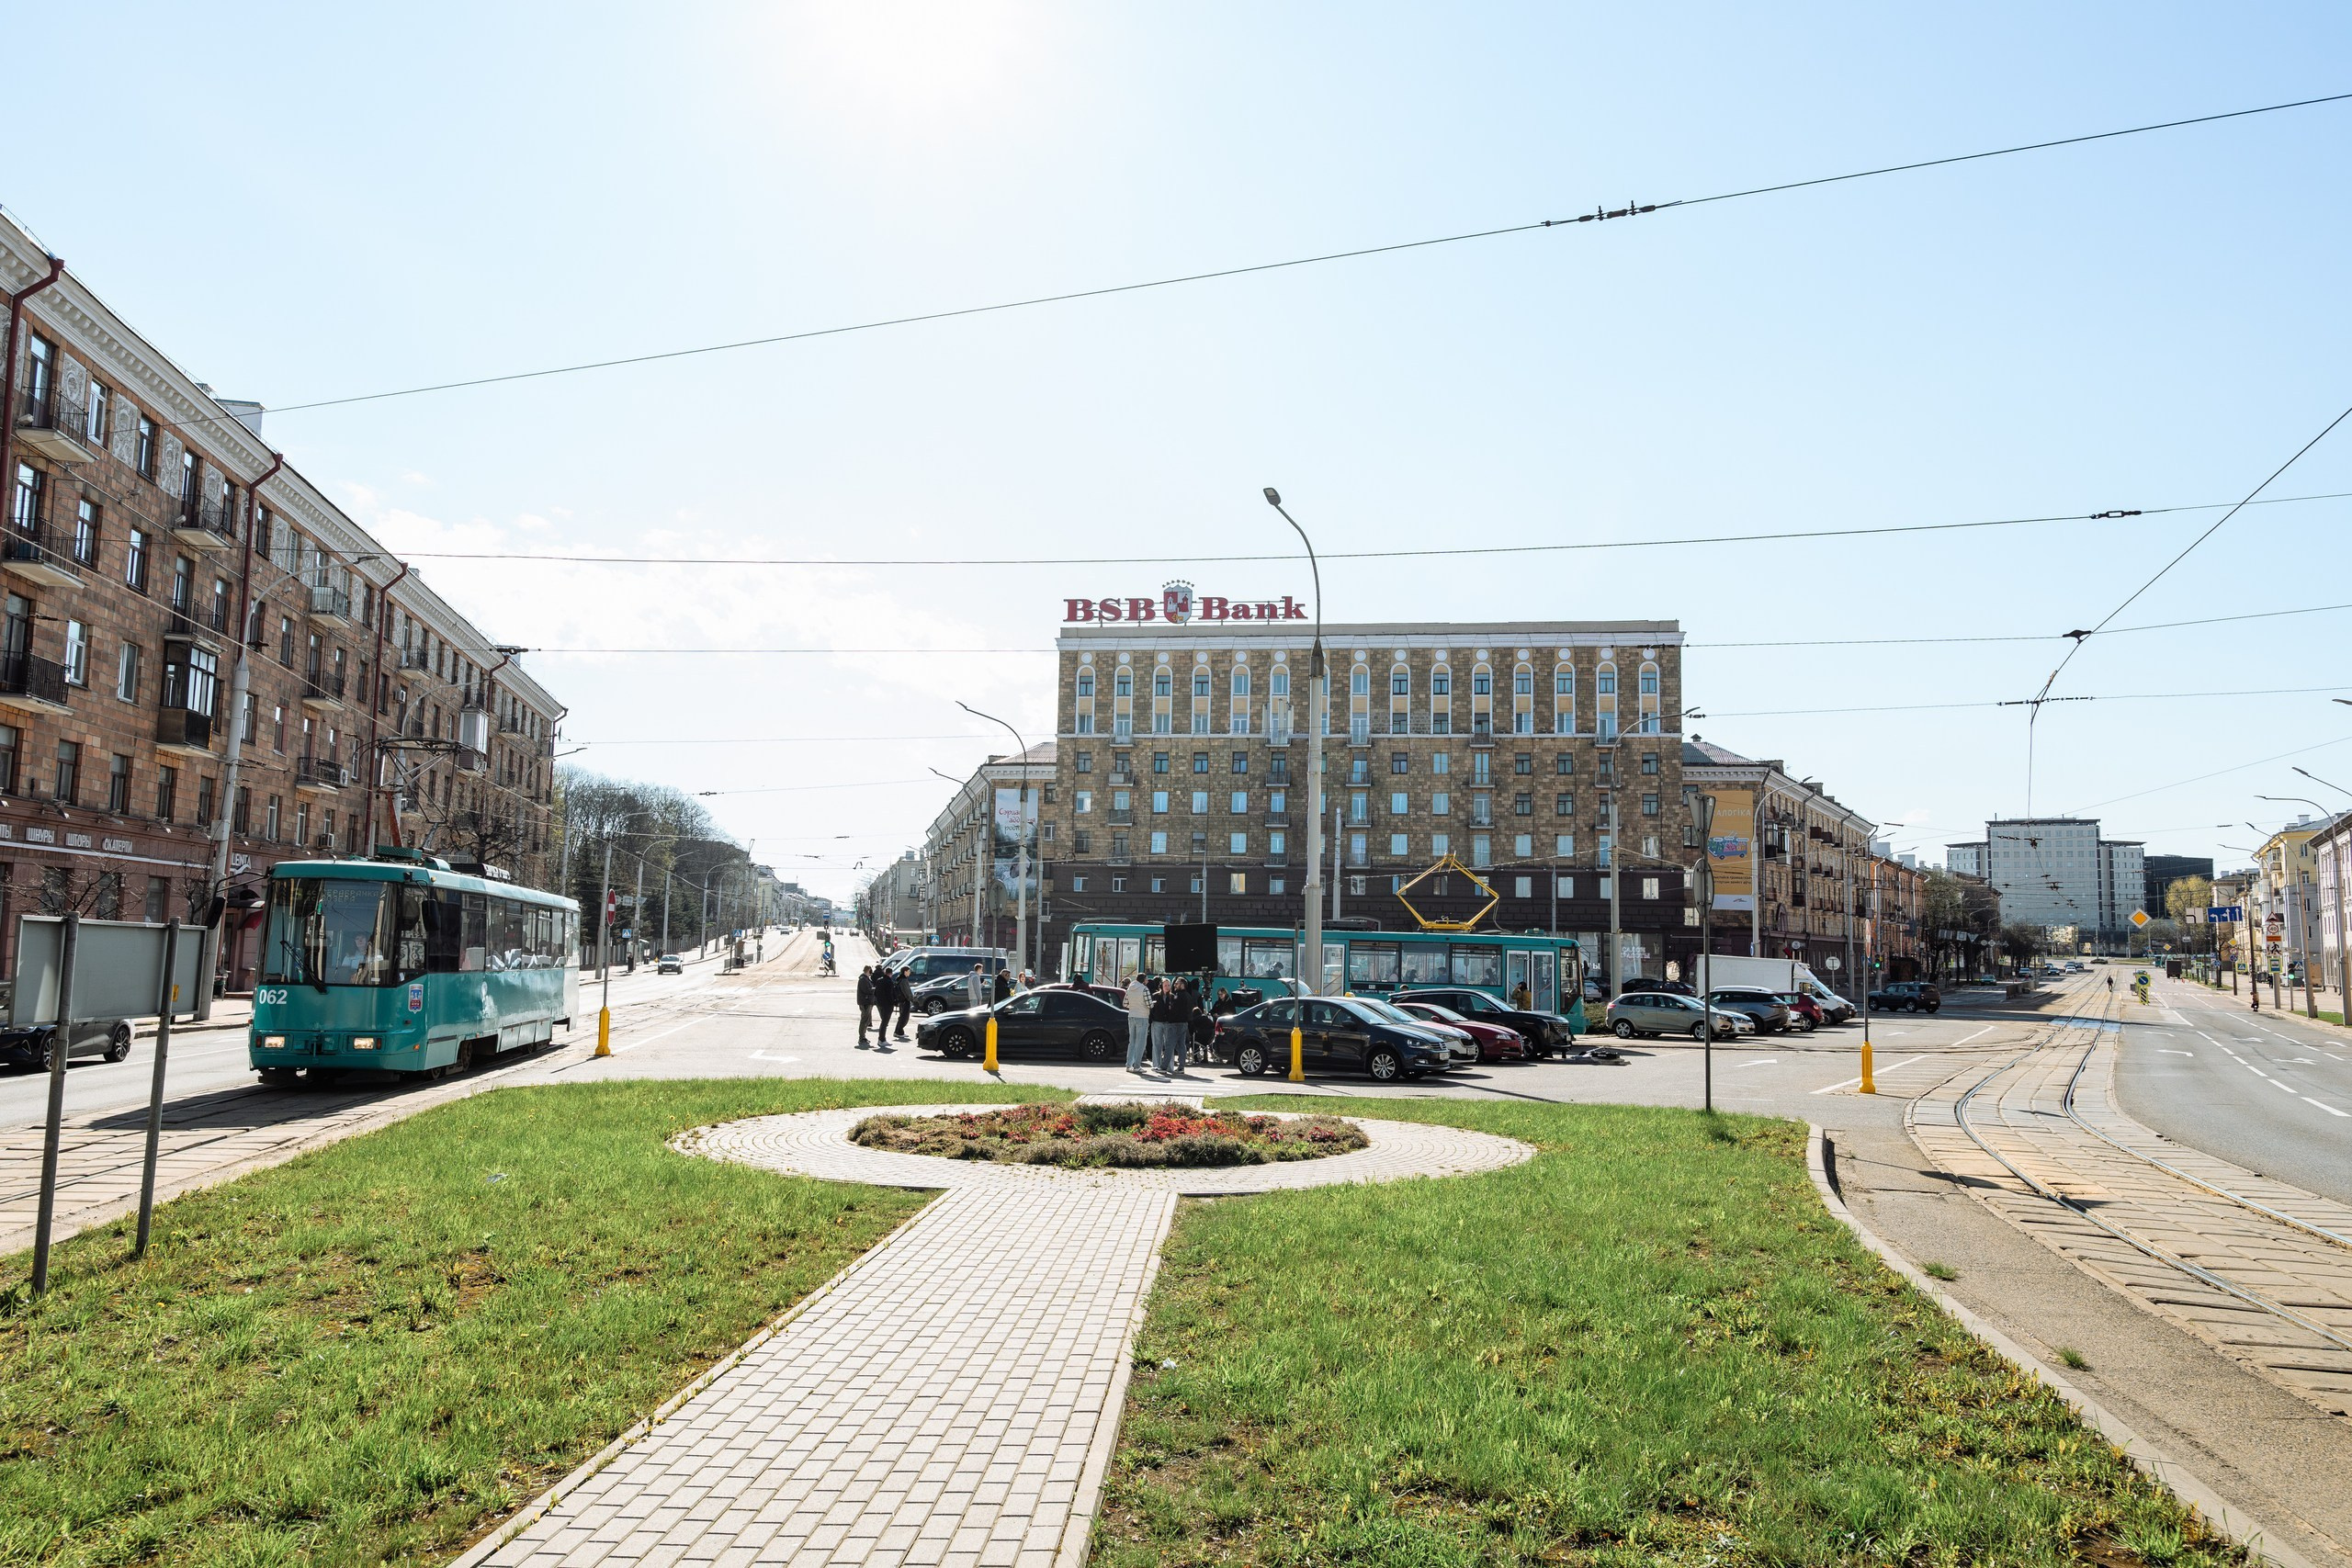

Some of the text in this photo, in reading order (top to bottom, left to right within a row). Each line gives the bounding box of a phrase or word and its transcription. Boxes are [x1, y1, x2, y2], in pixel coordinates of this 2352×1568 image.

[1063, 595, 1308, 622] BSB Bank
[0, 824, 133, 853] ТЫ ШНУРЫ ШТОРЫ СКАТЕРТИ
[259, 988, 288, 1005] 062
